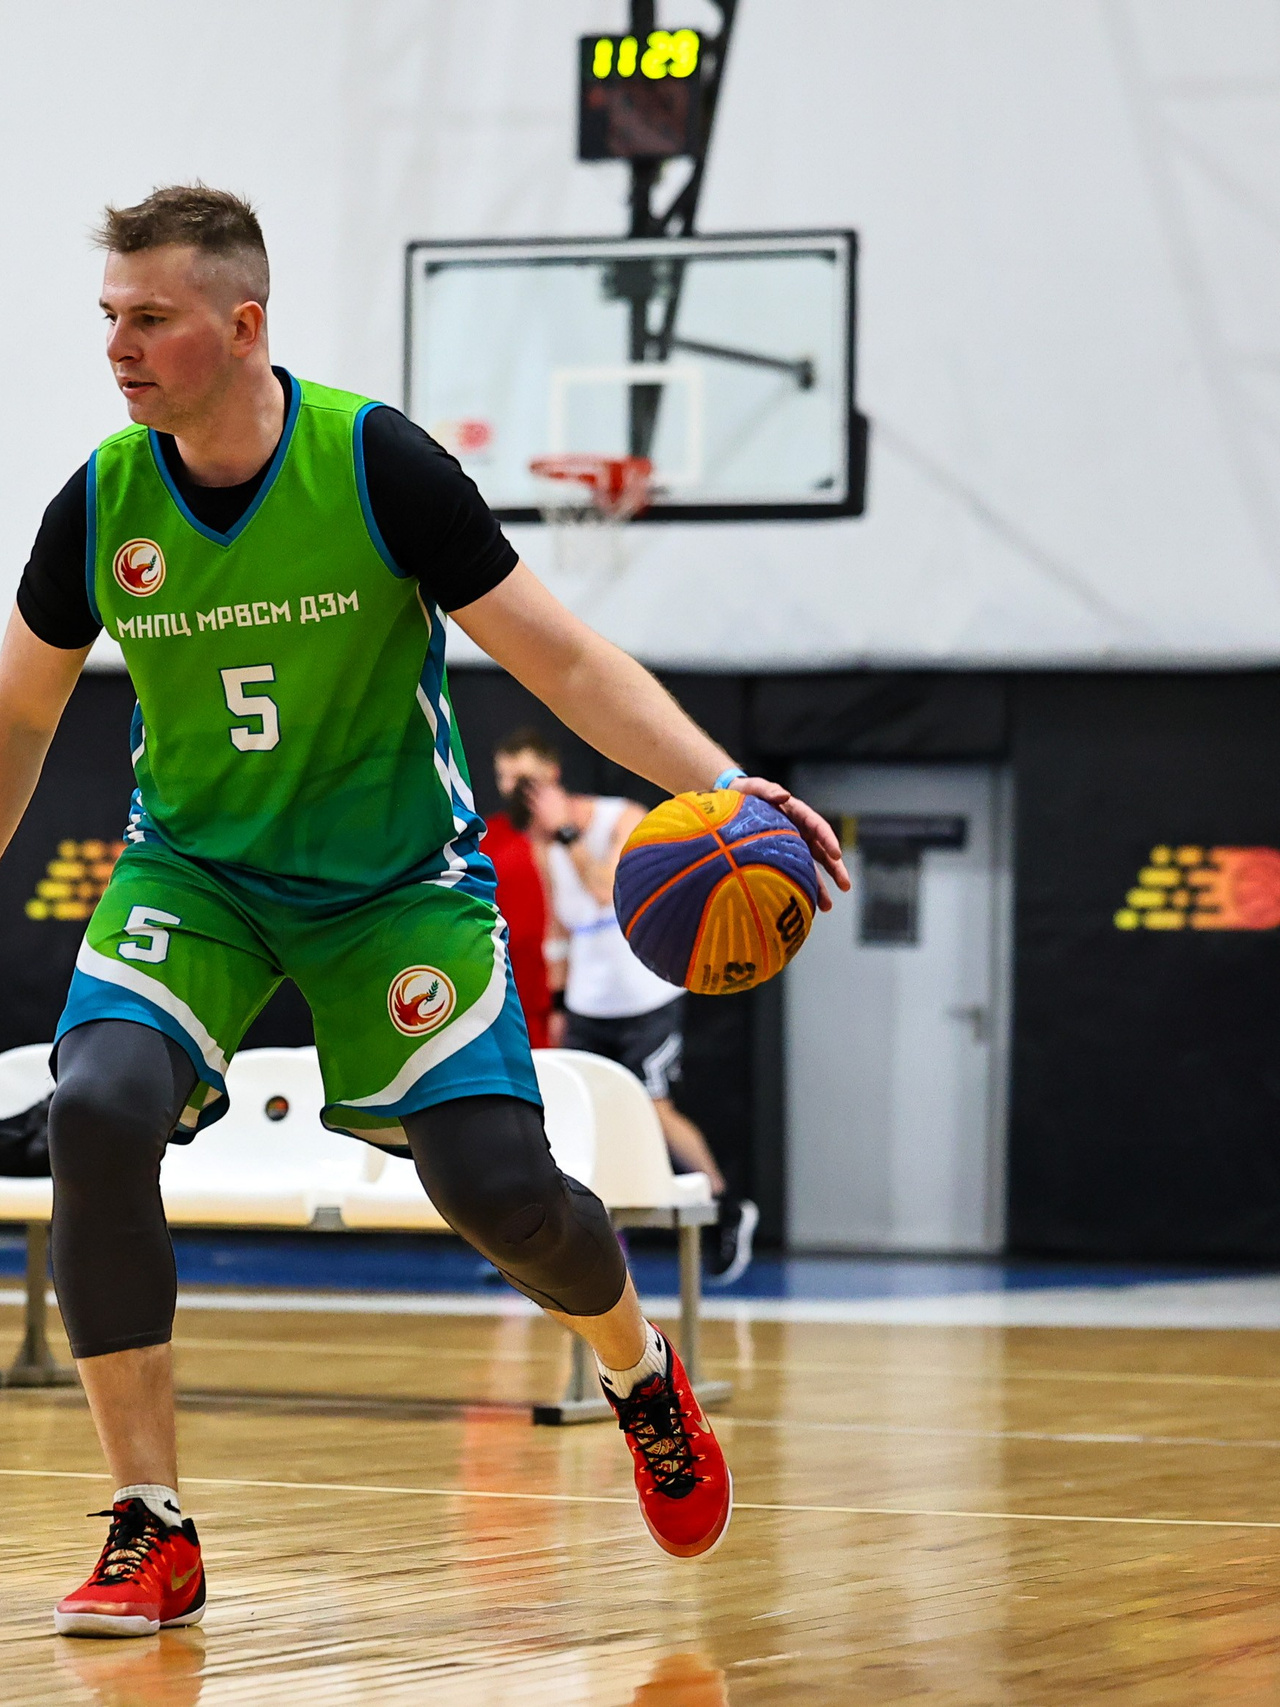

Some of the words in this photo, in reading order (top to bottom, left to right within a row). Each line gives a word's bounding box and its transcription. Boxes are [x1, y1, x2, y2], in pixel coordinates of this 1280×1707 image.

[116, 611, 192, 639] МНПЦ
[196, 599, 292, 633] МРВСМ
[299, 589, 359, 624] ДЗМ
[220, 663, 281, 752] 5
[117, 904, 181, 964] 5
